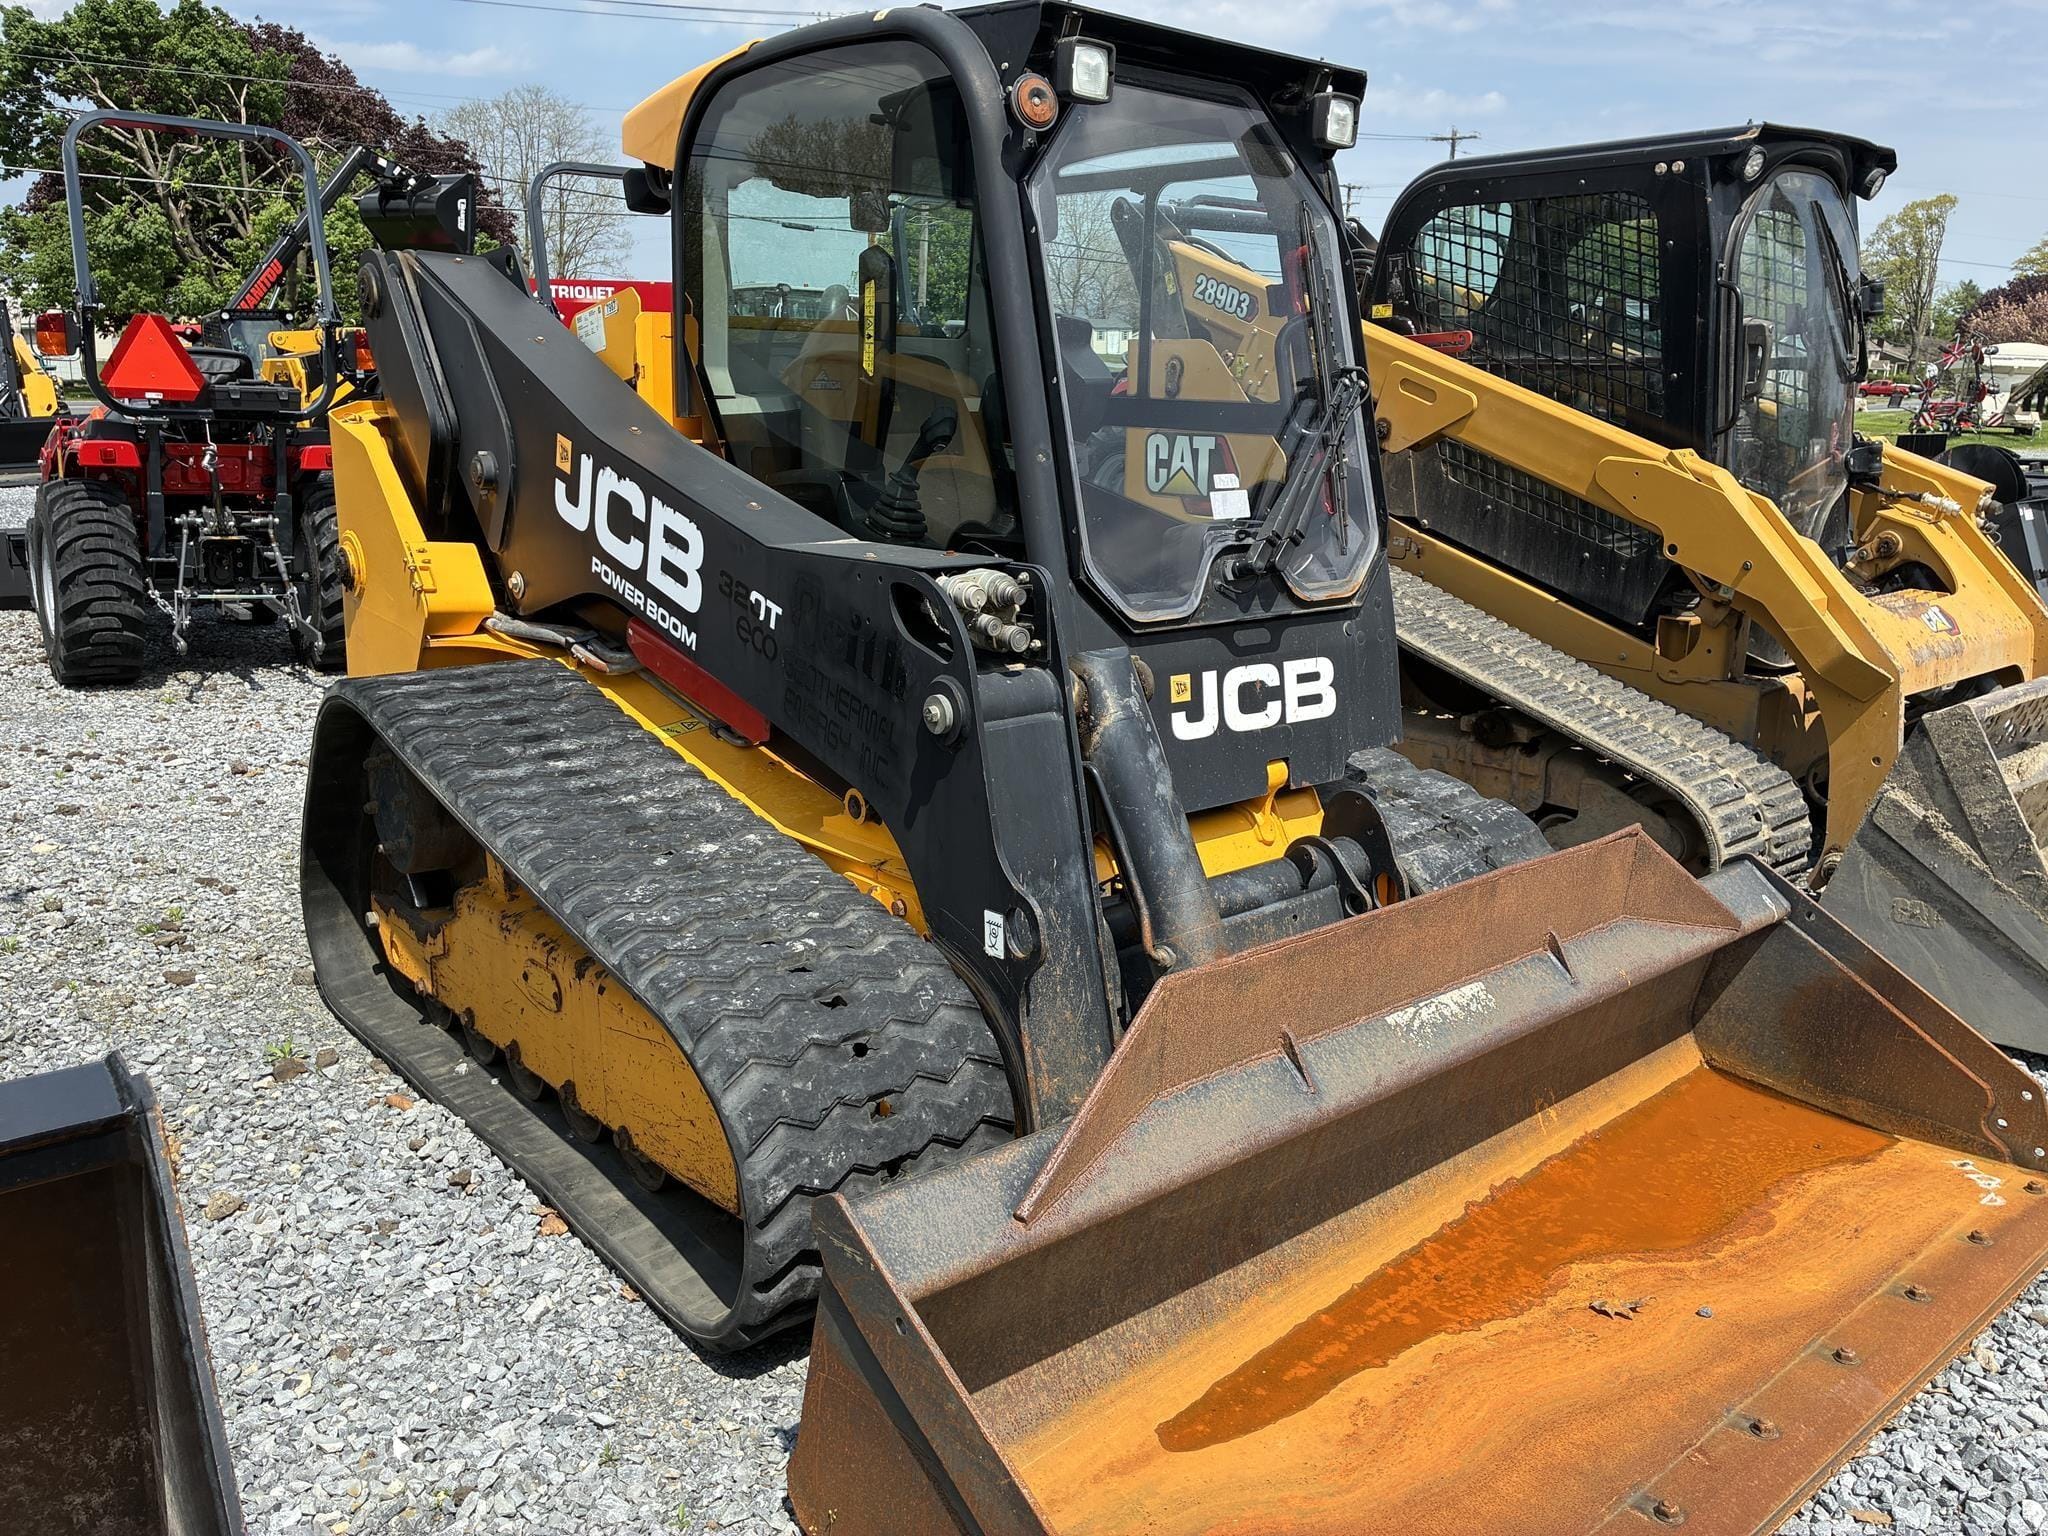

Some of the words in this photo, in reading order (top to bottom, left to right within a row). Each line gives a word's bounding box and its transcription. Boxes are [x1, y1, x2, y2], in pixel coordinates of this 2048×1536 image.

[550, 285, 614, 299] TRIOLIET
[1193, 274, 1250, 318] 289D3
[1147, 432, 1216, 496] CAT
[555, 453, 704, 614] JCB
[592, 556, 645, 611] POWER
[646, 598, 697, 651] BOOM
[1920, 606, 1953, 632] CAT
[1171, 656, 1337, 741] JCB
